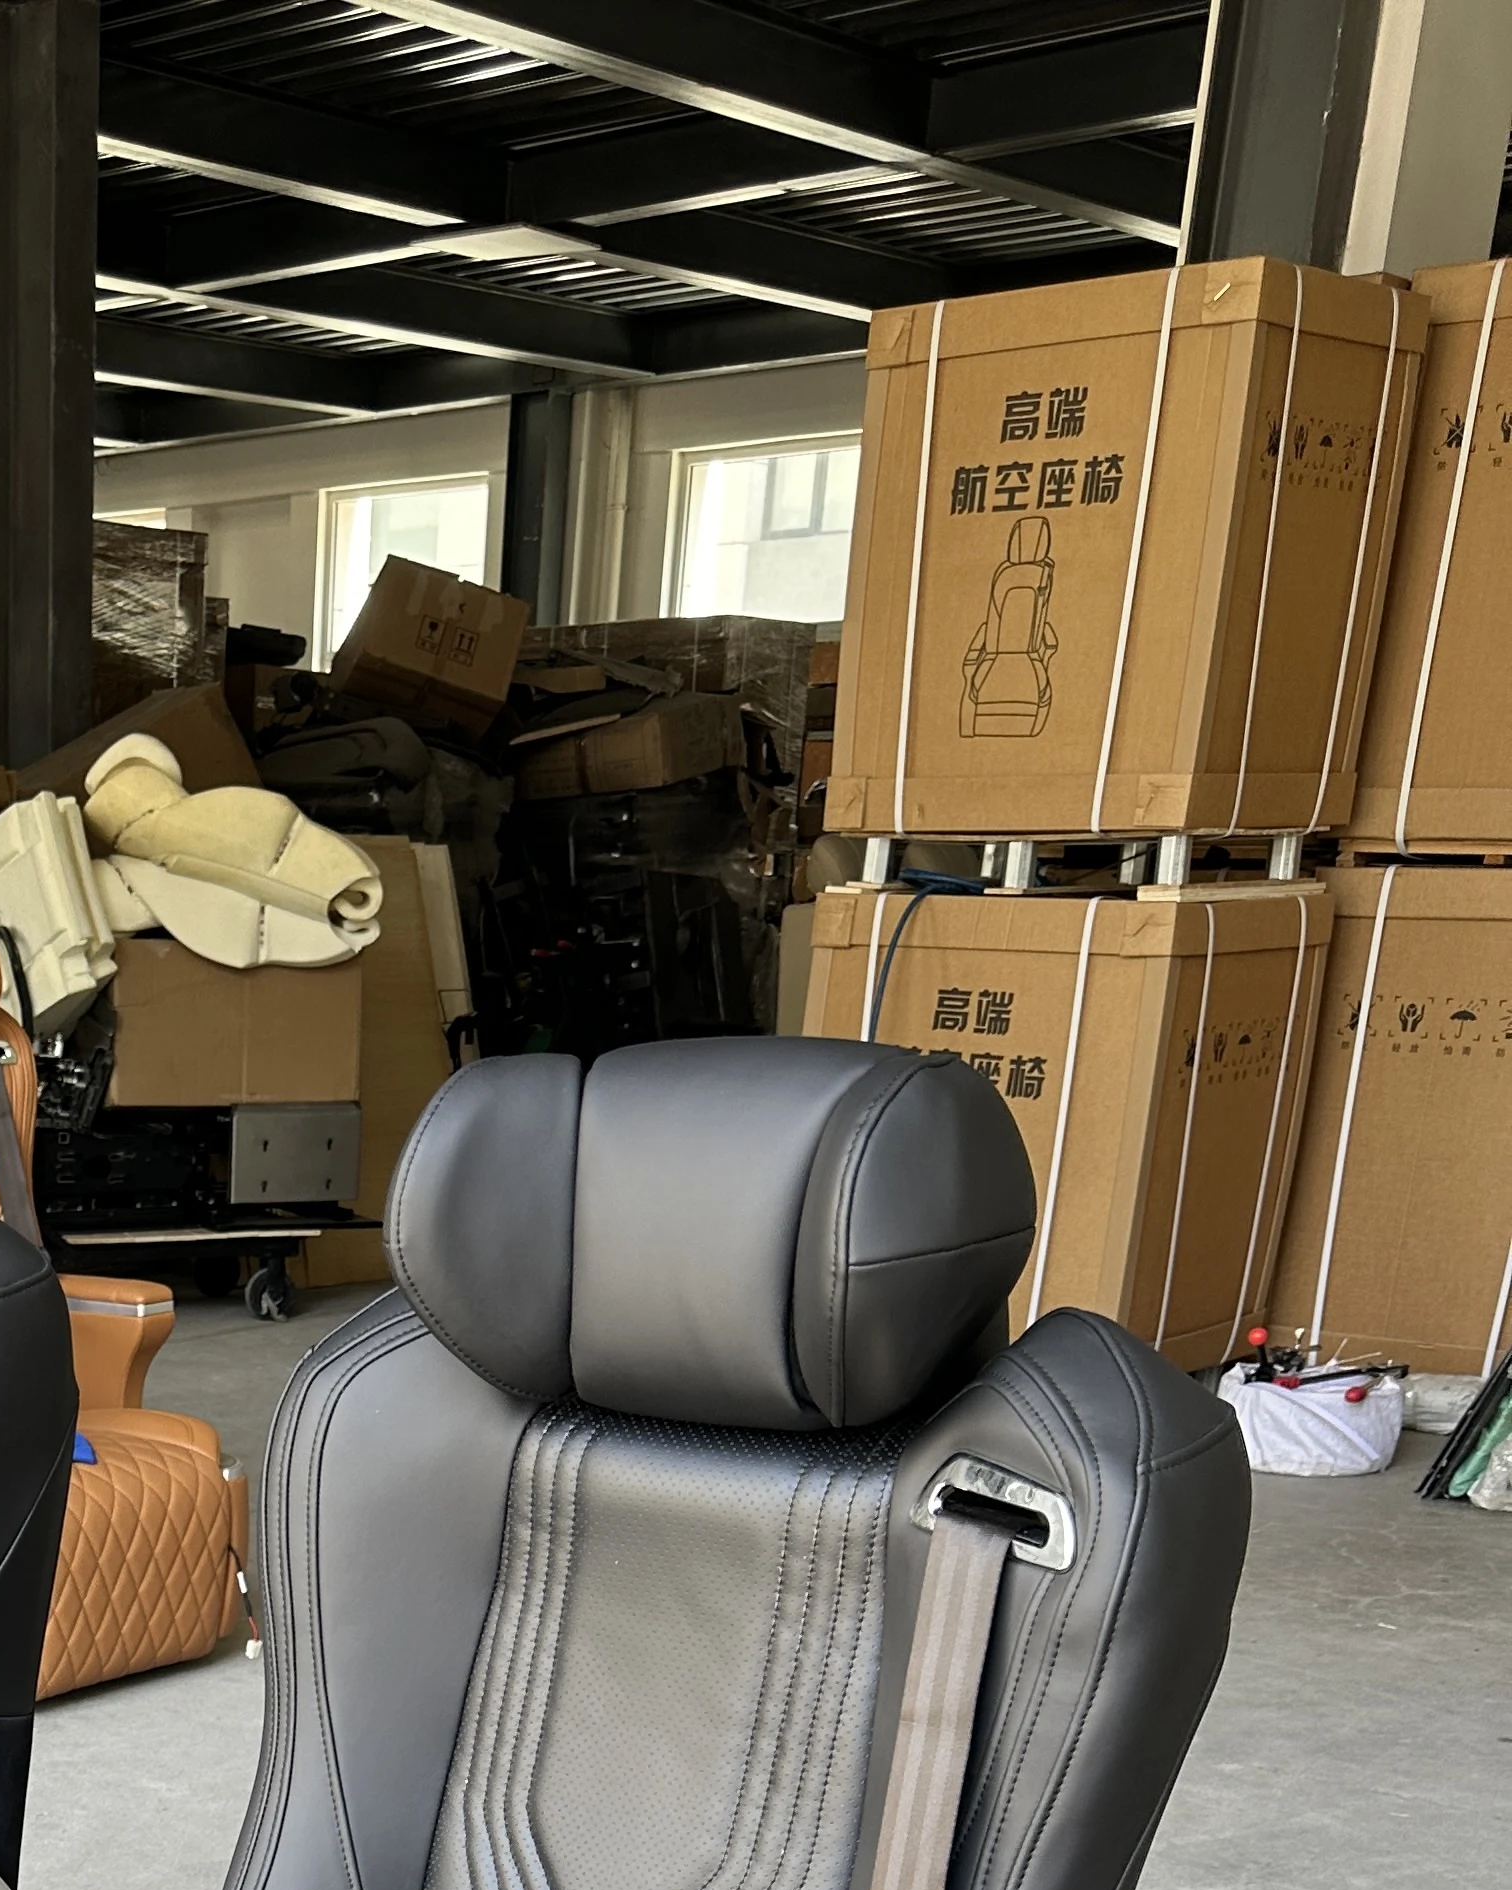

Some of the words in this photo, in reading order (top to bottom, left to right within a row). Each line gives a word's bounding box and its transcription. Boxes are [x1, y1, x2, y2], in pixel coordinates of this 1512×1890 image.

[1000, 386, 1088, 444] 高端
[950, 453, 1126, 516] 航空座椅
[932, 987, 1014, 1036] 高端
[895, 1045, 1048, 1100] 座椅
